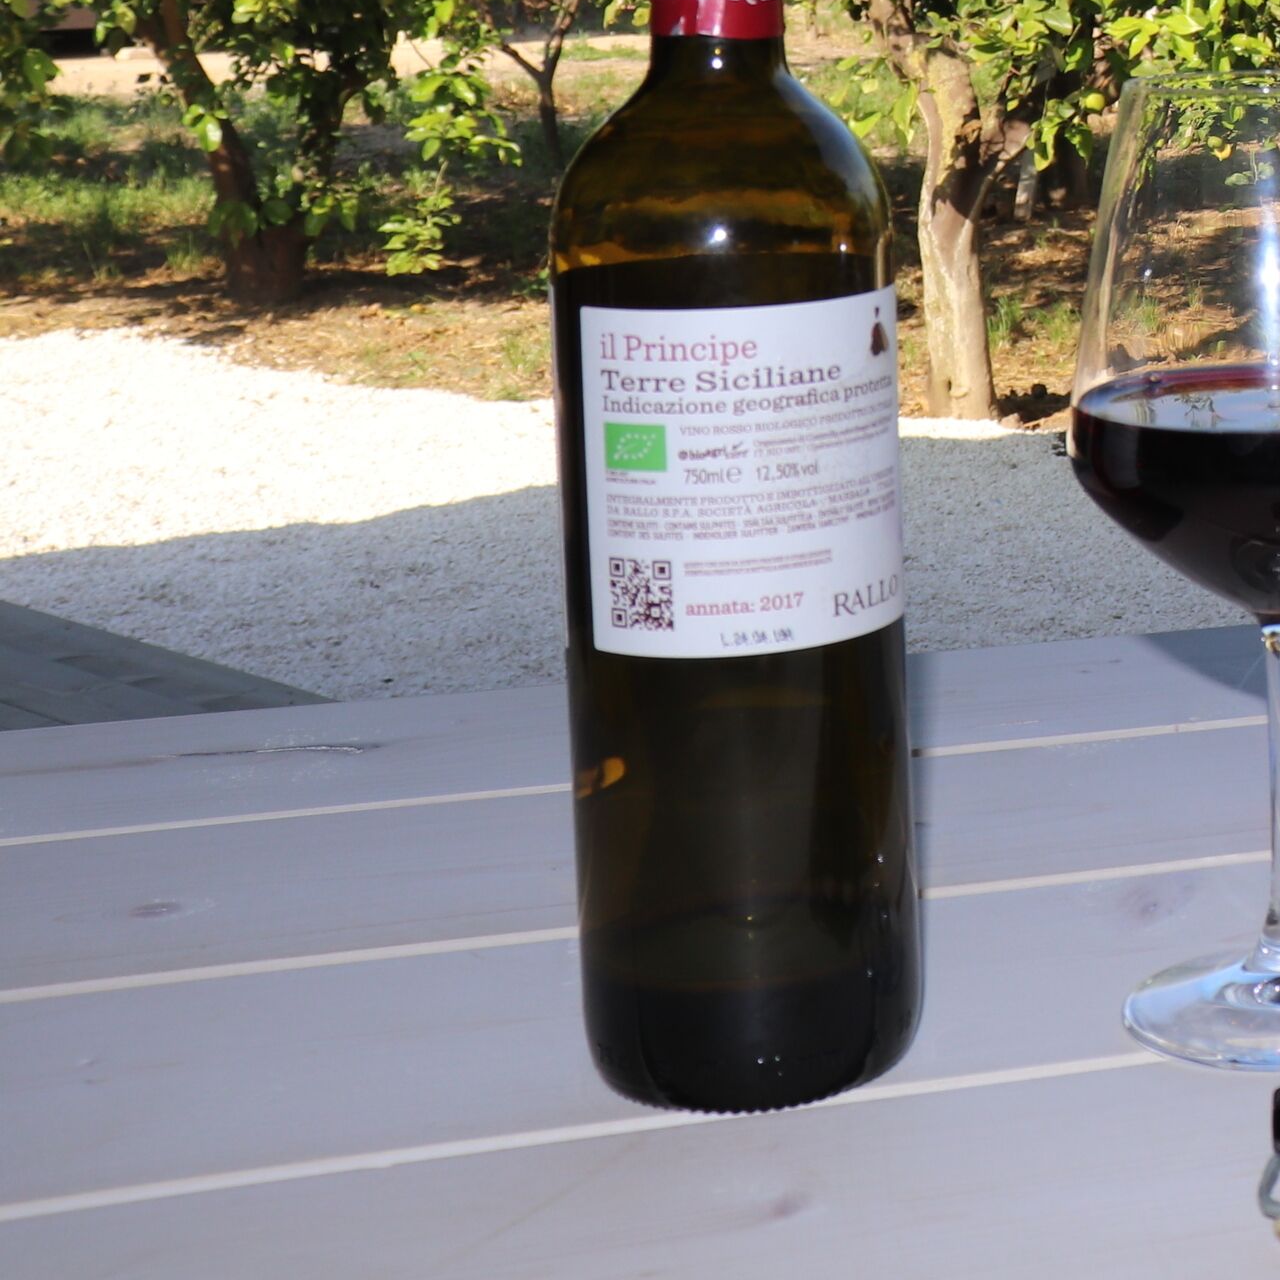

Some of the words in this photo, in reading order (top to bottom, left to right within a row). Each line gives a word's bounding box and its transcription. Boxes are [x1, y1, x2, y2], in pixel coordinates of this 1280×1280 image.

[601, 333, 616, 360] il
[624, 334, 758, 365] Principe
[601, 369, 685, 393] Terre
[695, 364, 841, 392] Siciliane
[601, 395, 727, 415] Indicazione
[732, 386, 839, 415] geografica
[680, 424, 710, 436] VINO
[712, 423, 752, 435] ROSSO
[683, 467, 725, 485] 750ml
[801, 460, 818, 475] vol
[624, 505, 658, 517] RALLO
[685, 600, 755, 617] annata:
[759, 591, 805, 612] 2017
[833, 574, 898, 617] RALLO
